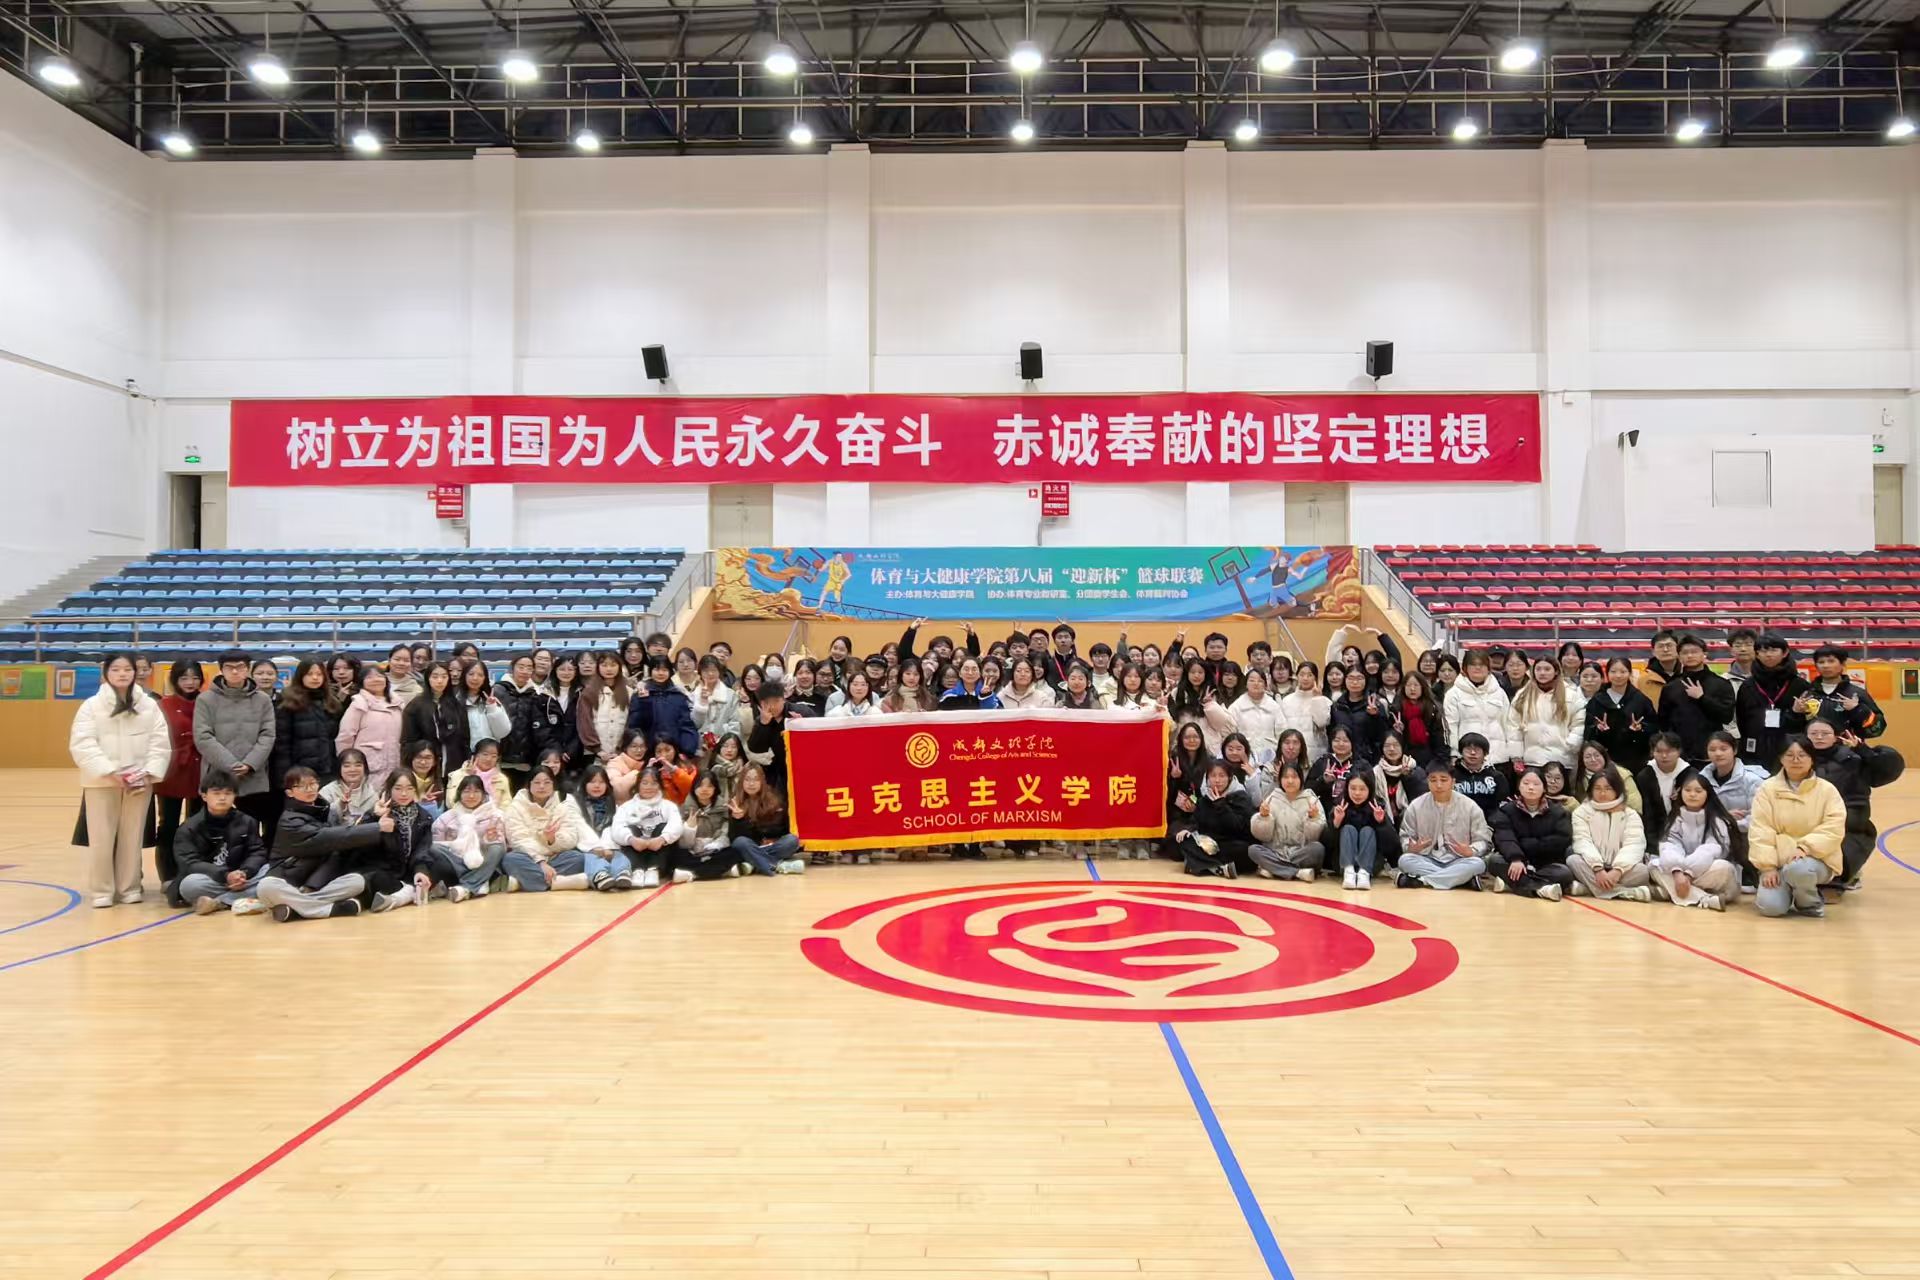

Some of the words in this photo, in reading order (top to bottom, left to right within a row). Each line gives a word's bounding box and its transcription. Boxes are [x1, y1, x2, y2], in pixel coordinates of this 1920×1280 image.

[285, 411, 942, 469] 树立为祖国为人民永久奋斗
[992, 410, 1490, 467] 赤诚奉献的坚定理想
[978, 752, 1000, 760] College
[825, 773, 1137, 819] 马克思主义学院
[903, 813, 966, 829] SCHOOL
[970, 811, 990, 825] OF
[993, 810, 1062, 824] MARXISM
